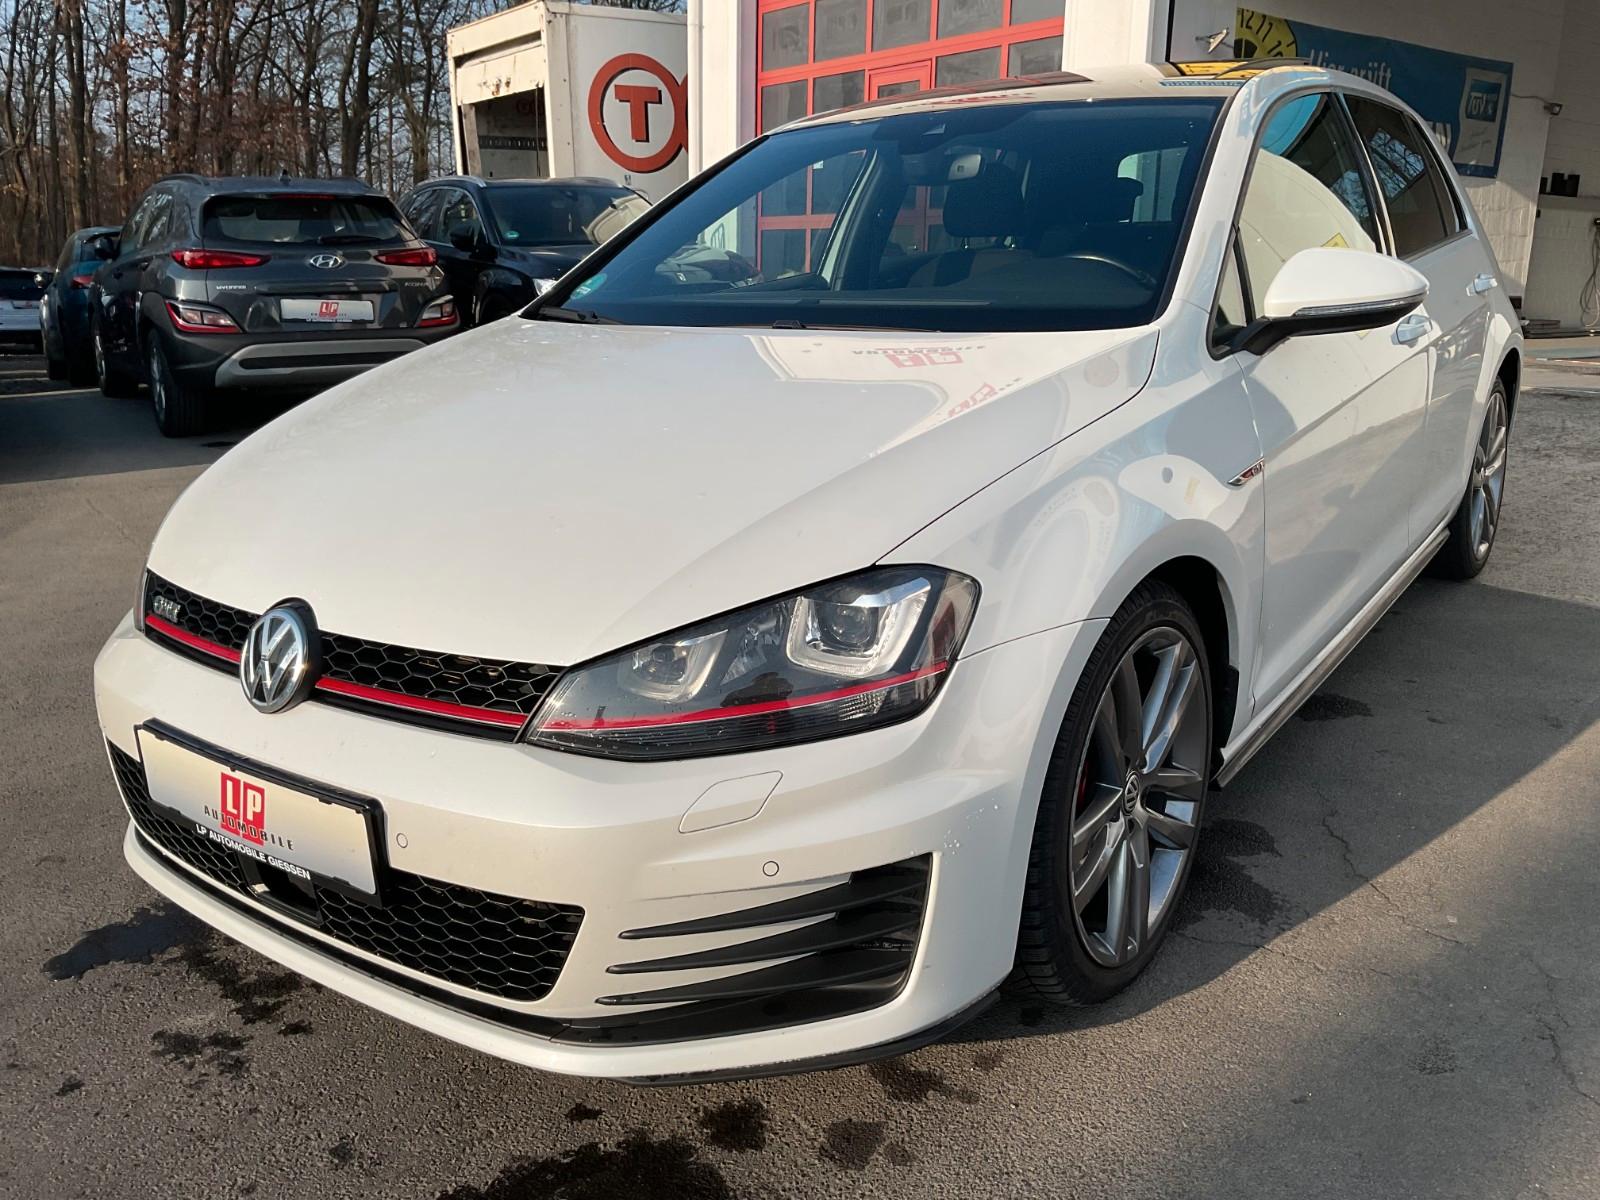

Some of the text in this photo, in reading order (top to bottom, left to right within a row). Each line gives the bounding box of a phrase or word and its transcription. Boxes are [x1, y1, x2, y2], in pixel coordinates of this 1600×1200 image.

[1240, 8, 1255, 30] 12
[615, 84, 662, 143] T
[226, 779, 262, 821] LP
[204, 805, 294, 851] AUTOMOBILE
[195, 823, 312, 881] LP AUTOMOBILE GIESSEN
